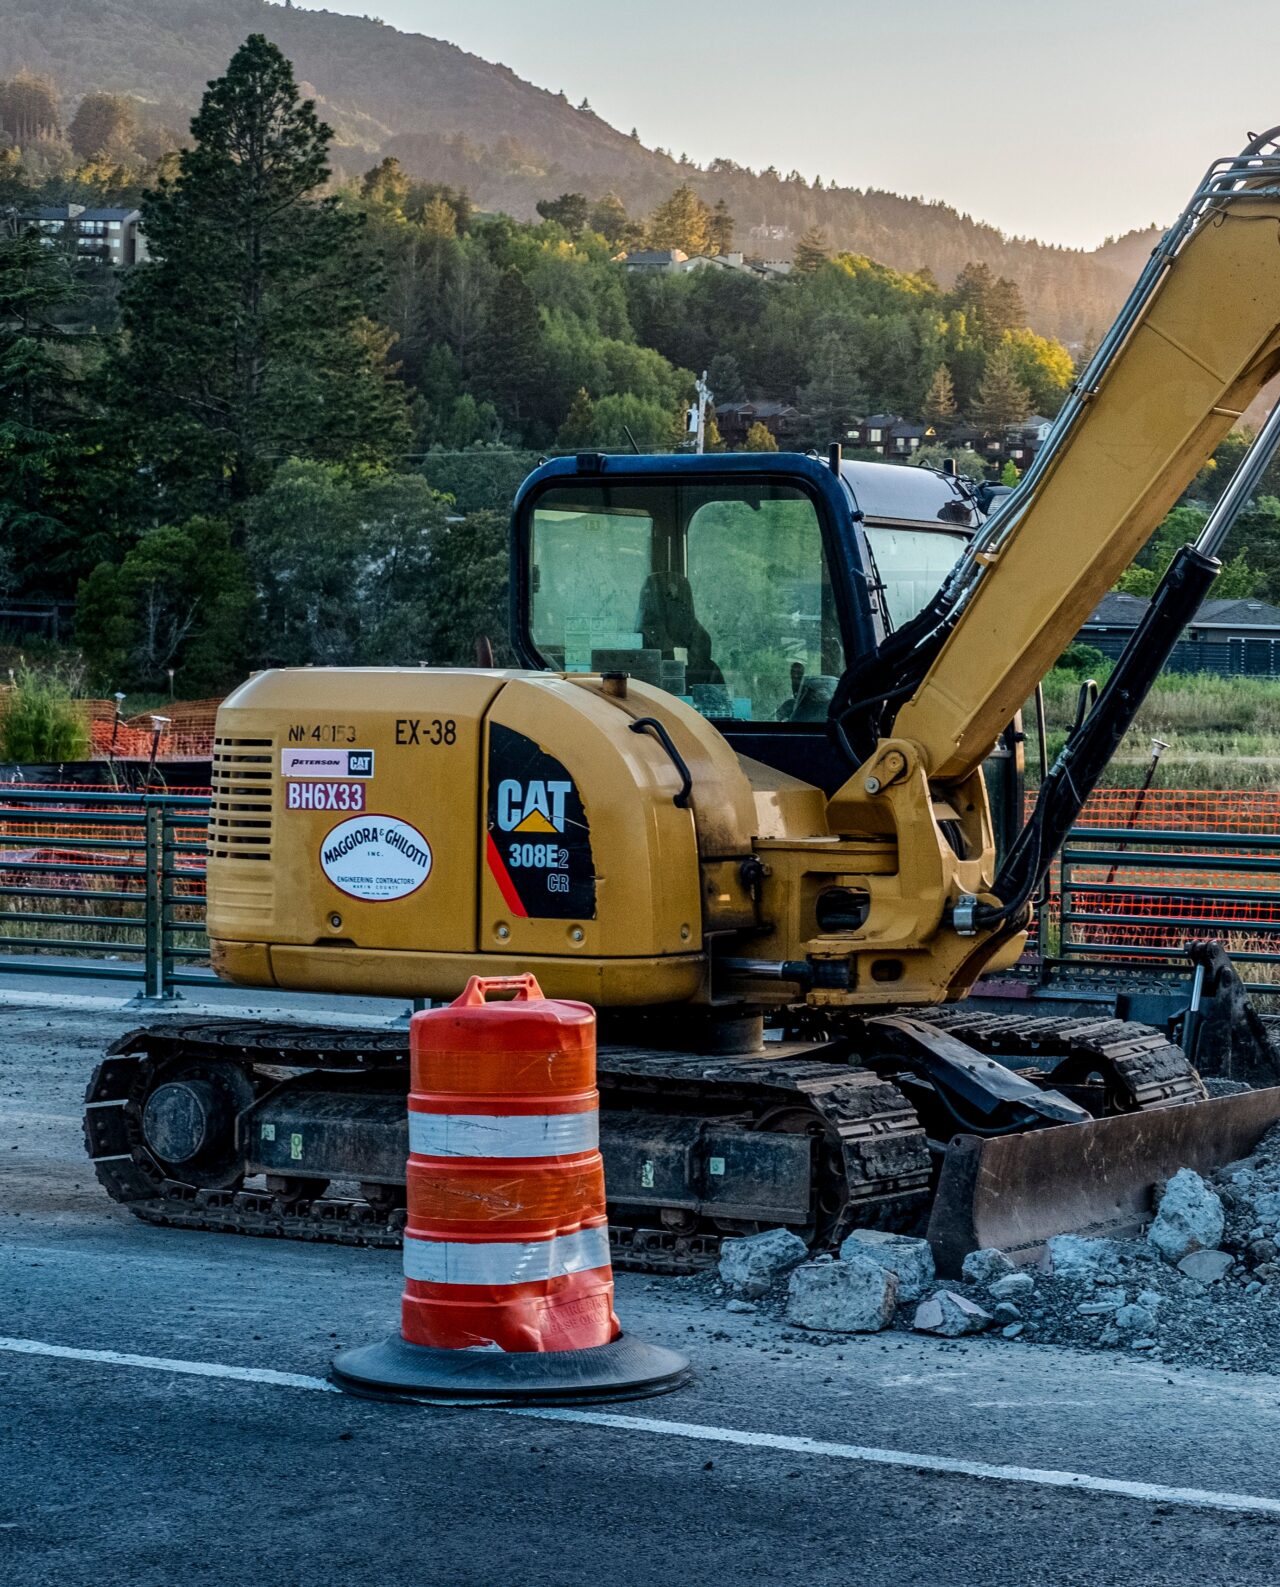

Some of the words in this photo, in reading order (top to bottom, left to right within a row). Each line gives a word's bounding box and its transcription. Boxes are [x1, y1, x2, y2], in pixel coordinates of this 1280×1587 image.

[395, 719, 457, 745] EX-38
[291, 759, 341, 768] PETERSON
[349, 756, 371, 771] CAT
[288, 782, 363, 810] BH6X33
[498, 779, 571, 833] CAT
[324, 828, 379, 864] MAGGIORA
[385, 830, 428, 868] GHILOTTI
[509, 843, 570, 869] 308E2
[337, 876, 373, 884] ENGINEERING
[375, 876, 415, 885] CONTRACTORS
[547, 873, 570, 893] CR
[550, 1319, 577, 1334] BASE
[580, 1310, 605, 1326] ONLY
